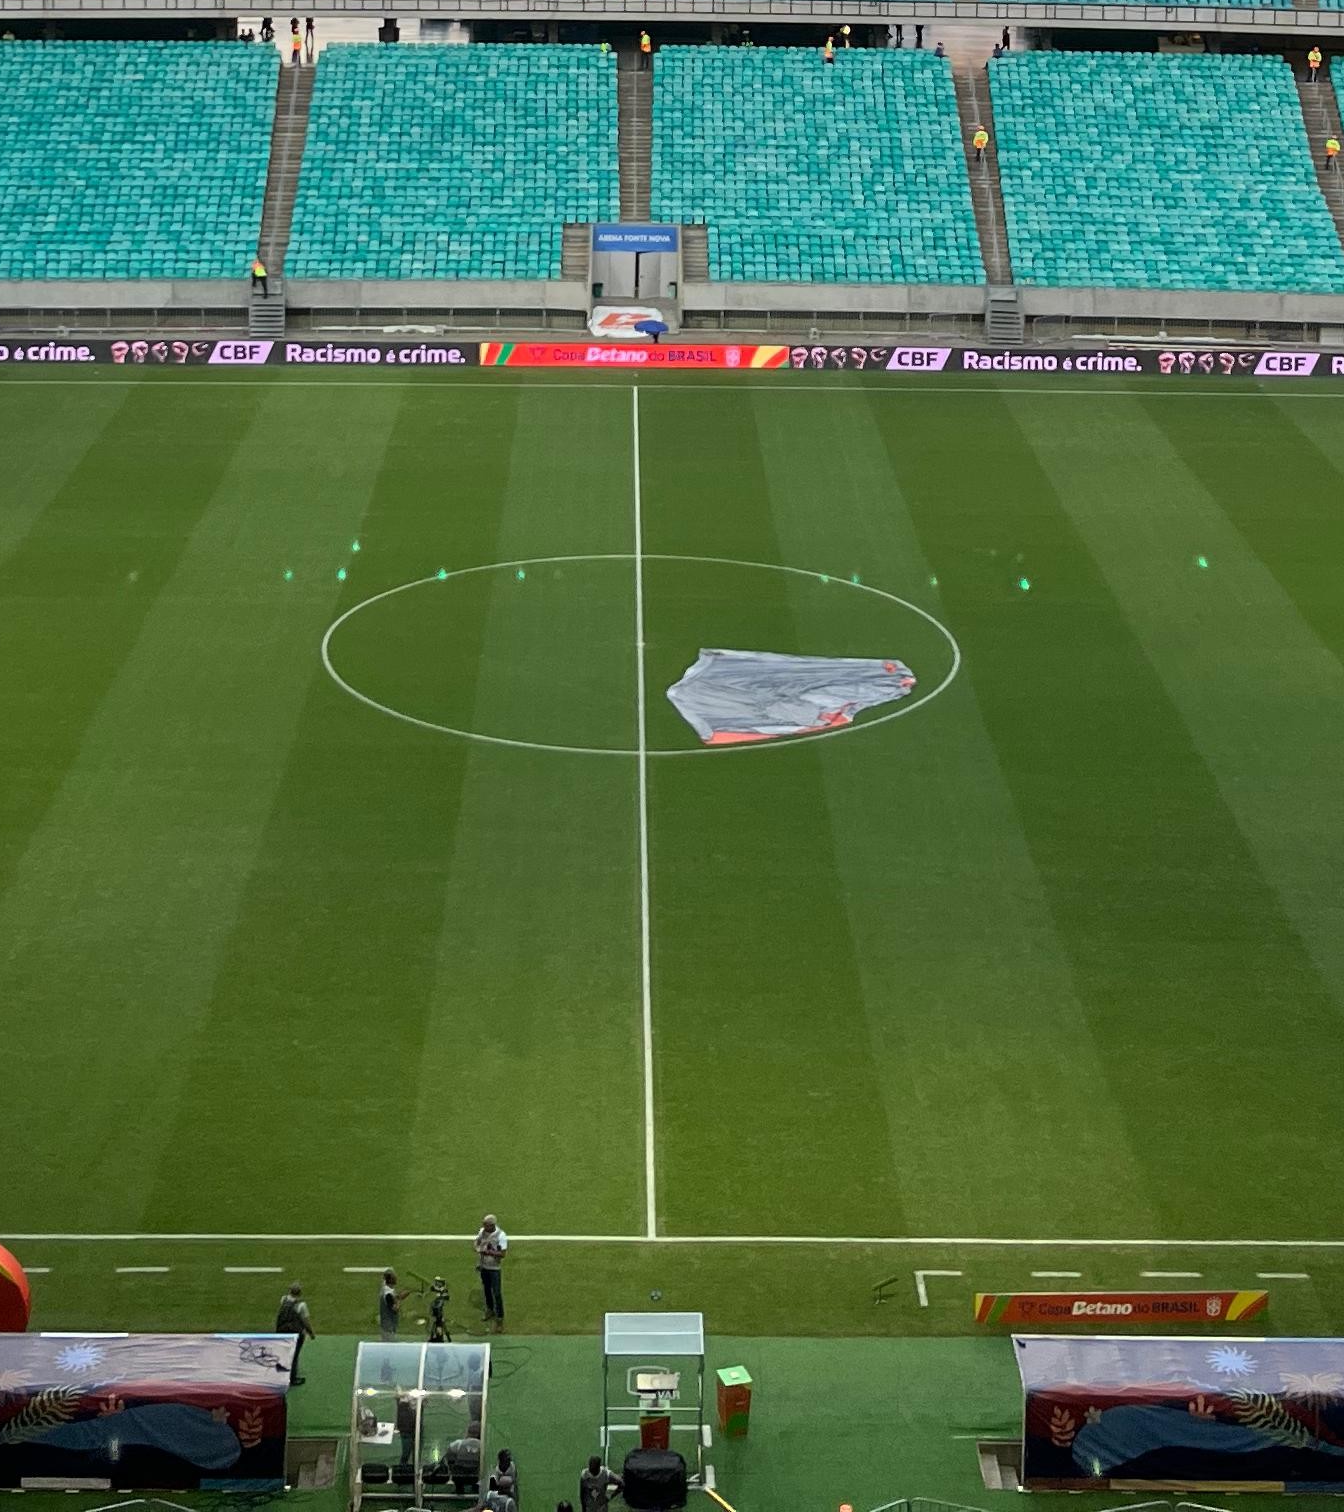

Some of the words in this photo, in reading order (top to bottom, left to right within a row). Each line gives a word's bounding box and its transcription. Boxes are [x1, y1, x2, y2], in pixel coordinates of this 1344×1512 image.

[647, 234, 671, 242] NOVA
[27, 342, 96, 361] crime.
[219, 345, 261, 360] CBF
[286, 343, 381, 363] Racismo
[399, 343, 466, 363] crime.
[585, 346, 648, 364] Betano
[897, 351, 938, 367] CBF
[963, 350, 1057, 371] Racismo
[1076, 352, 1142, 372] crime.
[1265, 356, 1306, 371] CBF
[1071, 1300, 1132, 1316] Betano
